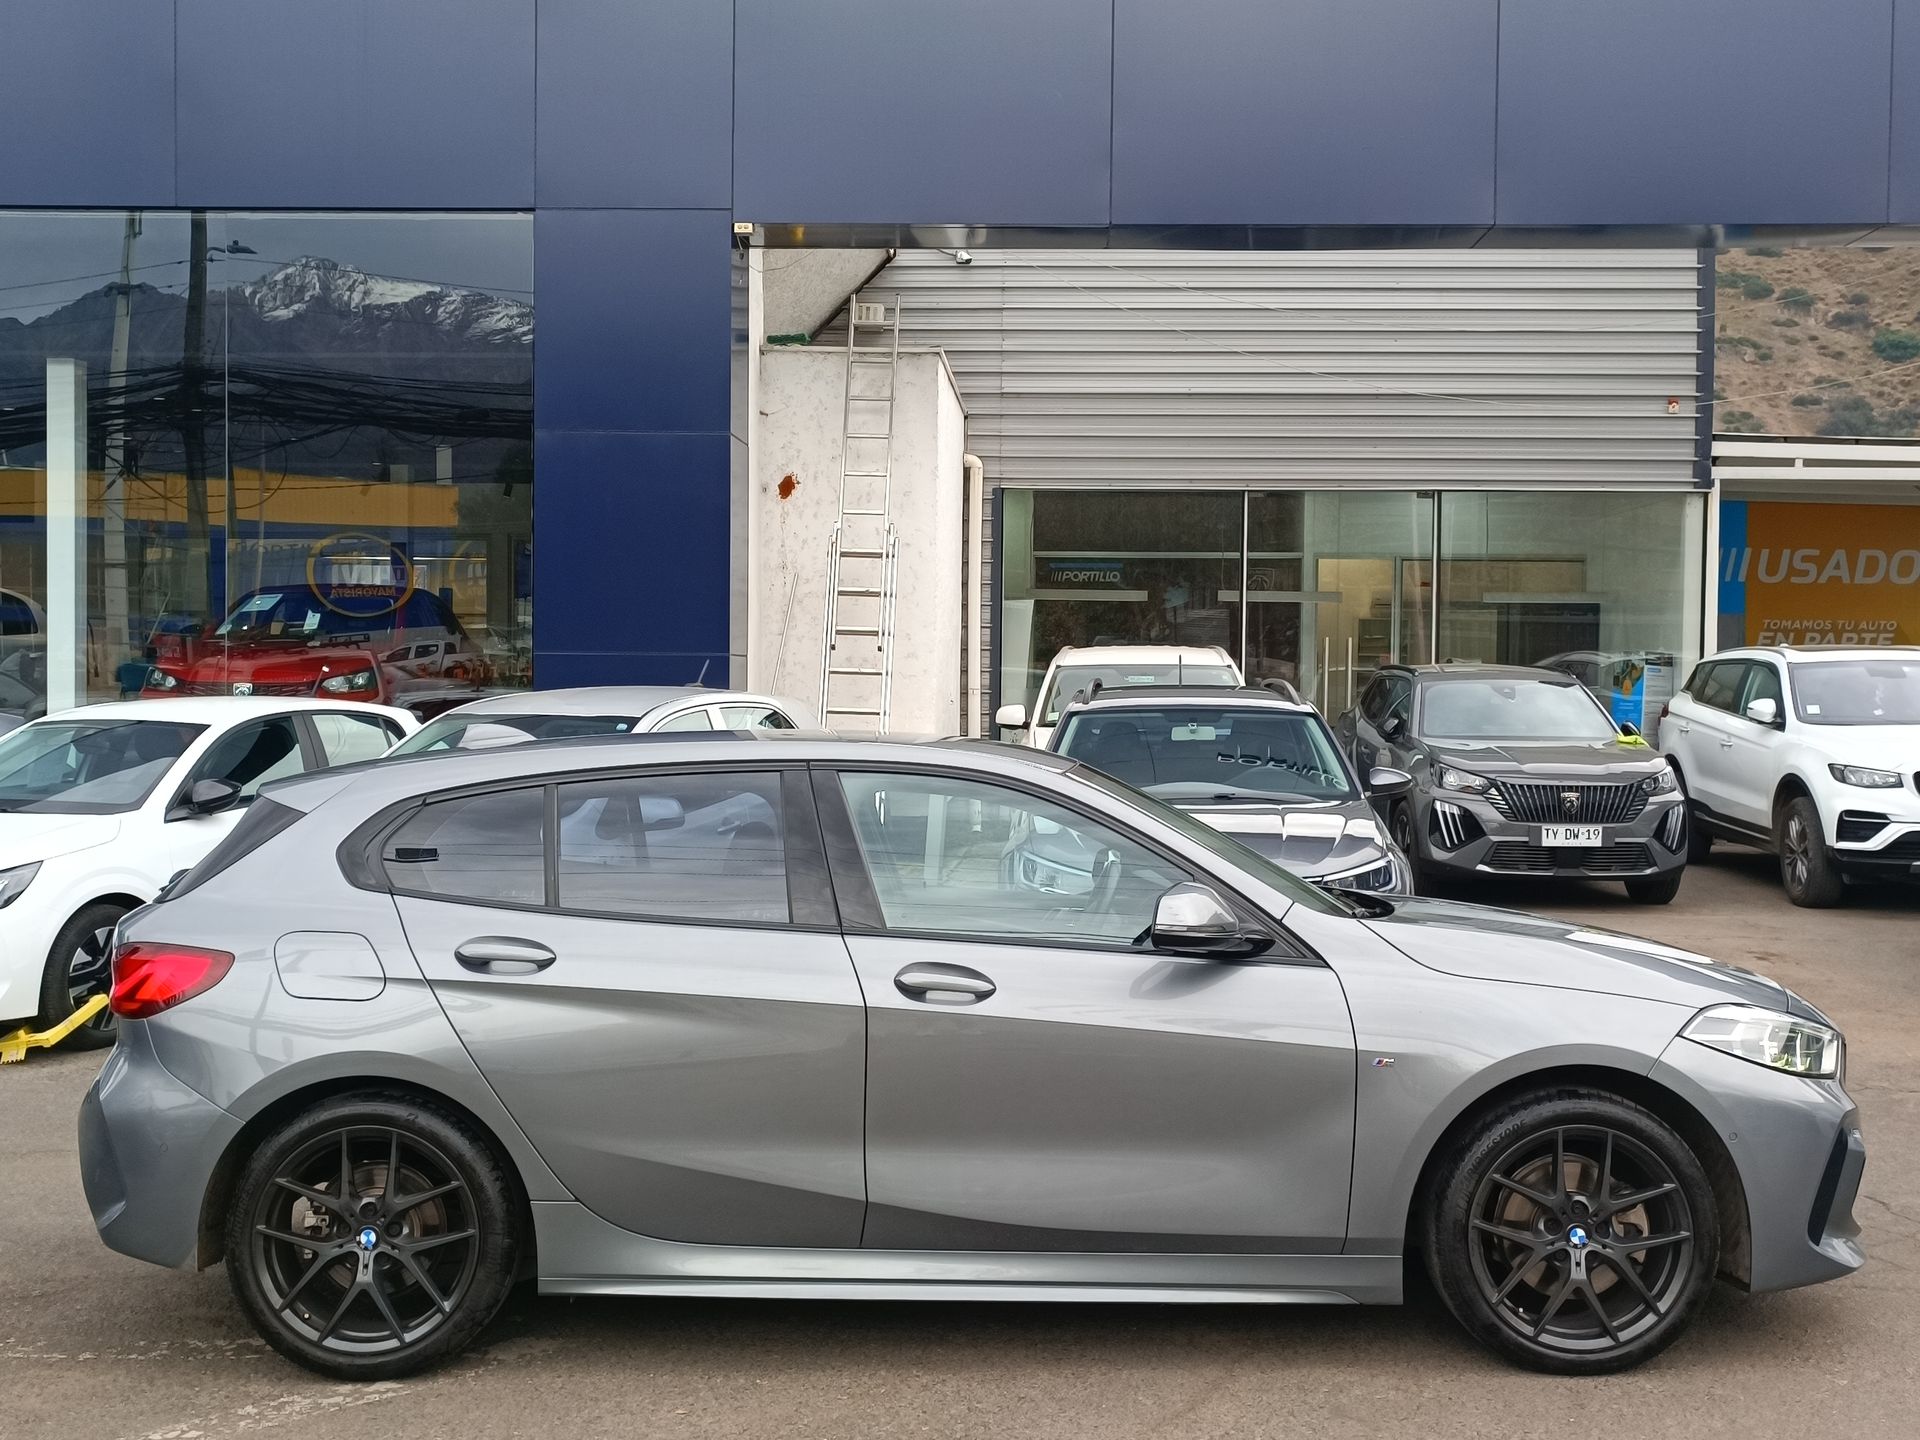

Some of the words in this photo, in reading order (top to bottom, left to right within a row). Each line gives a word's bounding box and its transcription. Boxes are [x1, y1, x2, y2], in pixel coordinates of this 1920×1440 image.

[1757, 548, 1920, 585] USADO
[1763, 619, 1832, 630] TOMAMOS
[1837, 620, 1854, 631] TU
[1857, 620, 1898, 631] AUTO
[1756, 631, 1795, 646] EN
[1803, 632, 1895, 646] PARTE
[1544, 828, 1560, 841] TY
[1564, 828, 1580, 841] DW
[1585, 828, 1601, 841] 19
